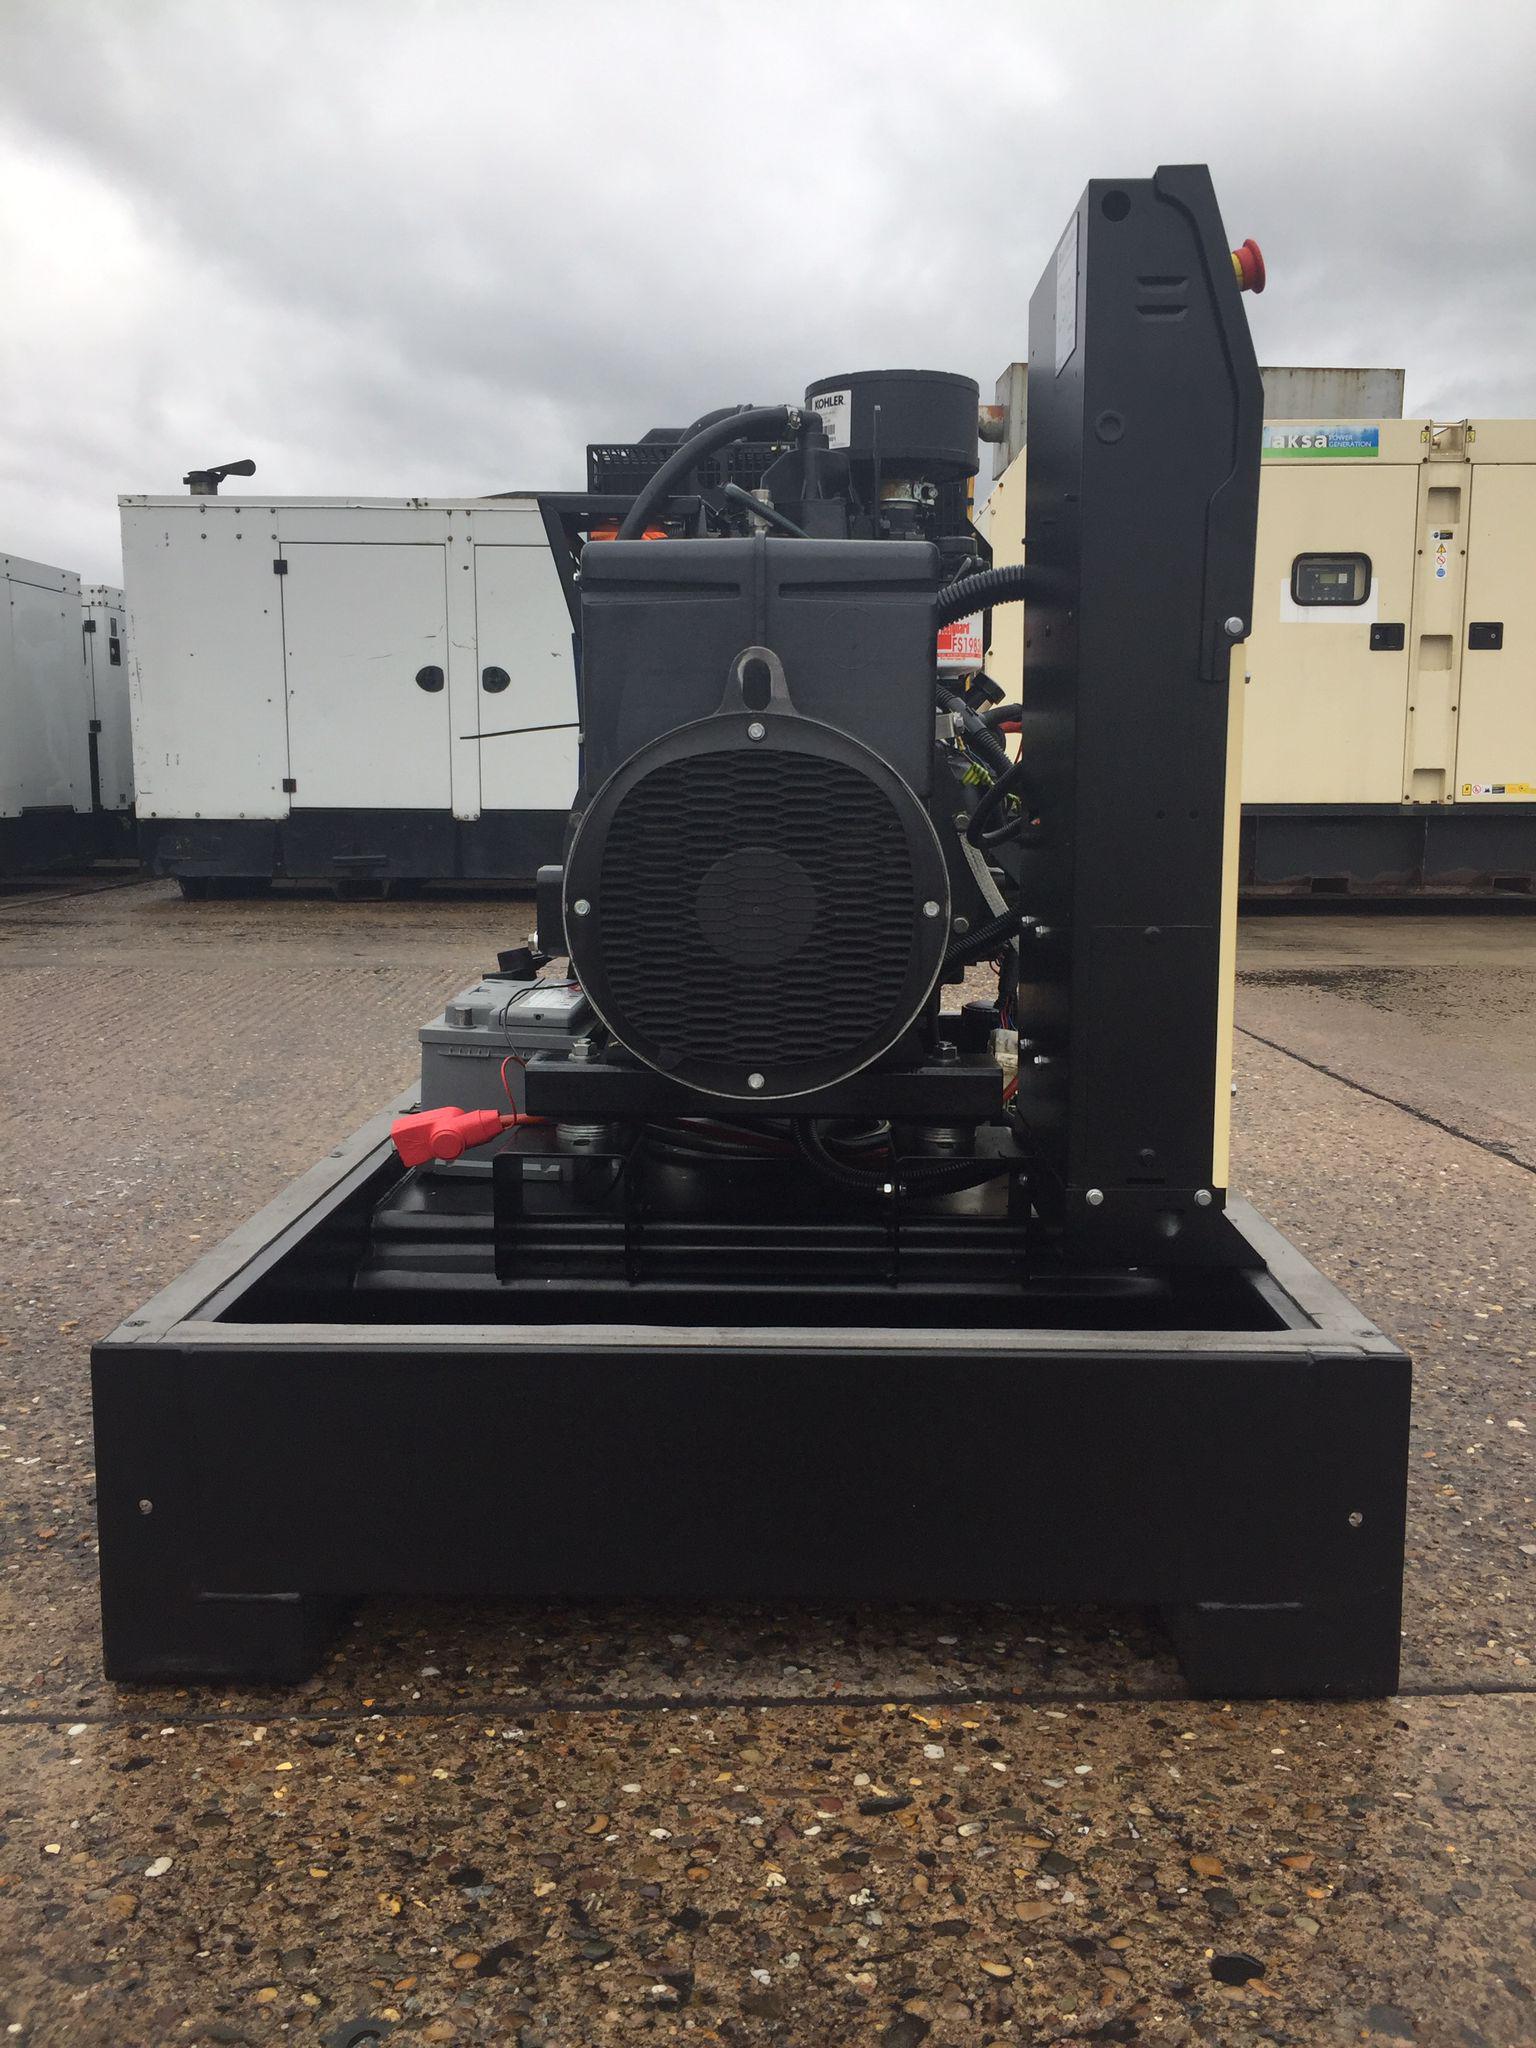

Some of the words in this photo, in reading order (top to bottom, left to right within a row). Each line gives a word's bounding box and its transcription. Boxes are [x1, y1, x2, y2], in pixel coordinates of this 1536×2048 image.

[815, 395, 844, 410] KOHLER
[1271, 434, 1329, 449] aksa
[1328, 440, 1372, 448] GENERATION
